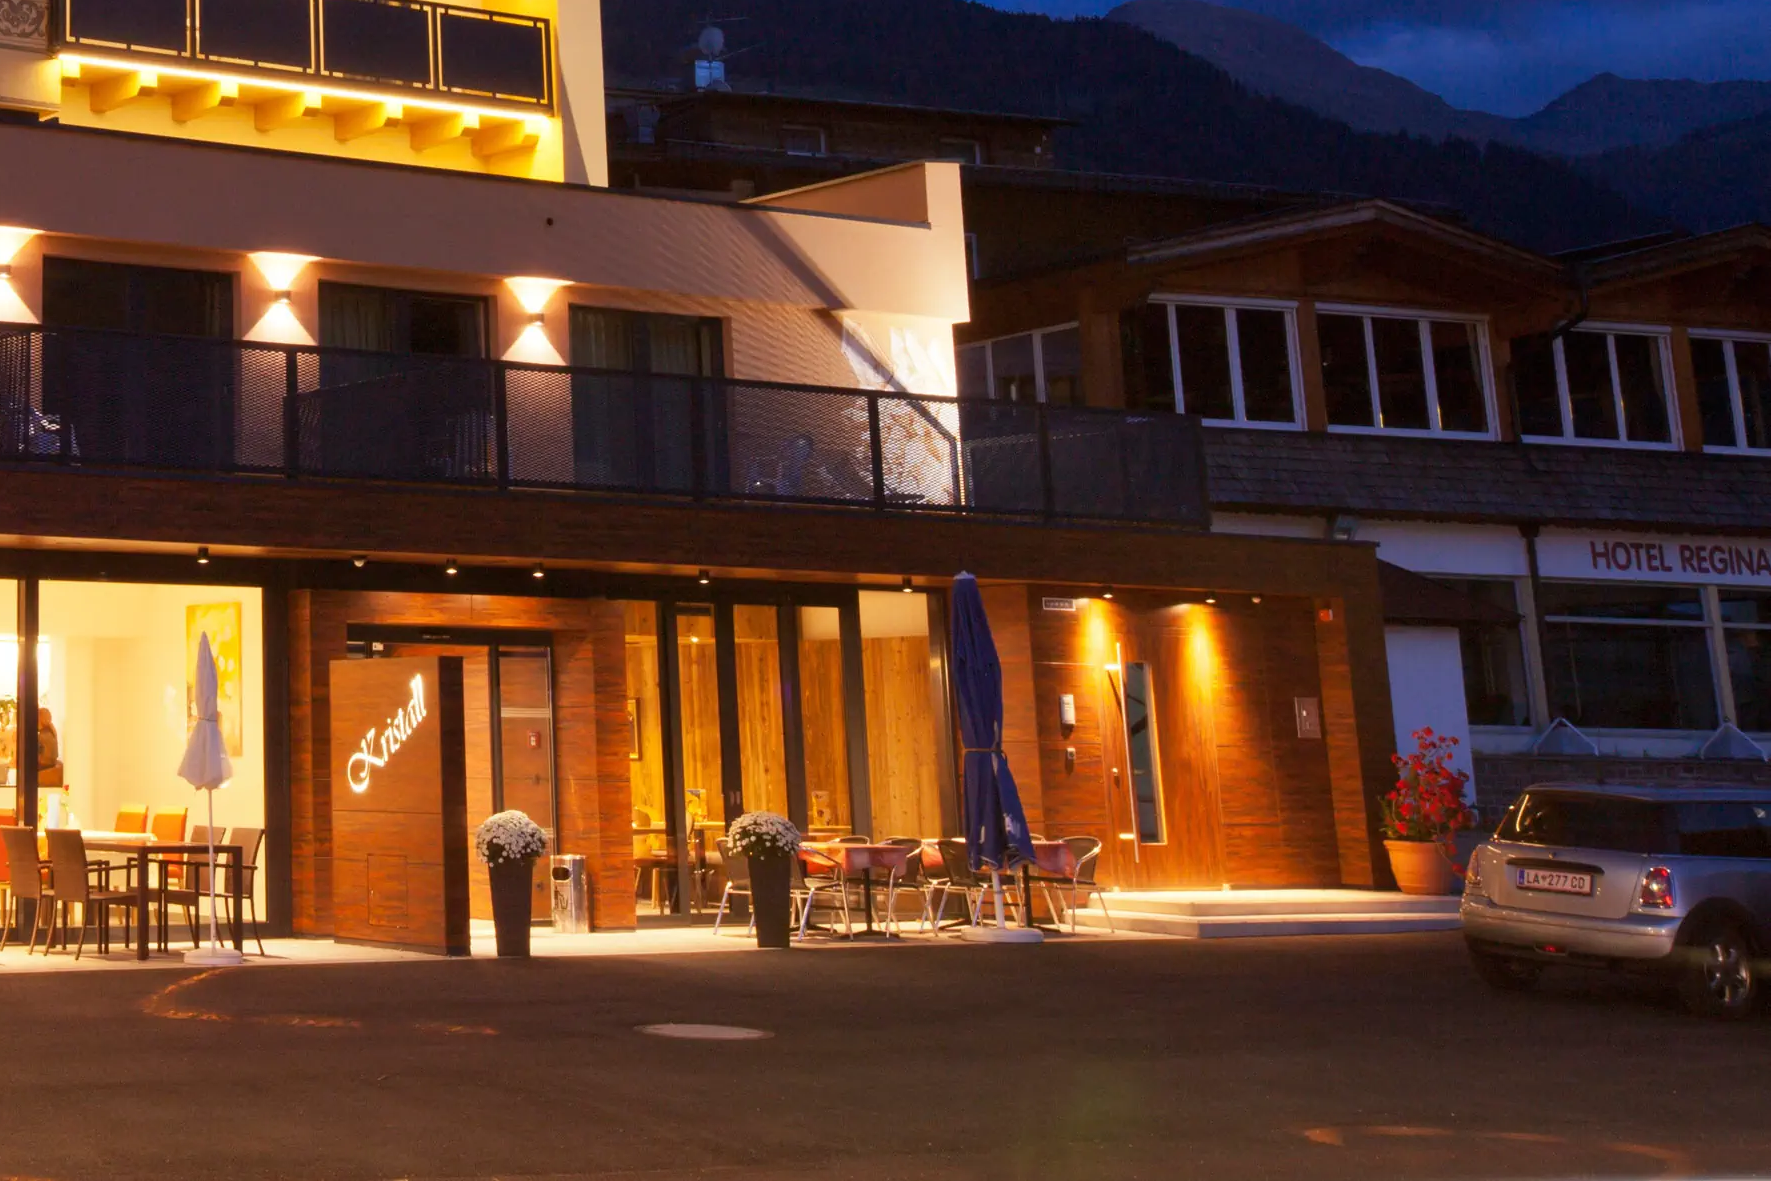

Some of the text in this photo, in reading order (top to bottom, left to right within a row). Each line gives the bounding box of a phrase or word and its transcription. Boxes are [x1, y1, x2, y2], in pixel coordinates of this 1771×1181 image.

[1590, 540, 1771, 576] HOTEL REGINA
[347, 673, 427, 793] Kristall
